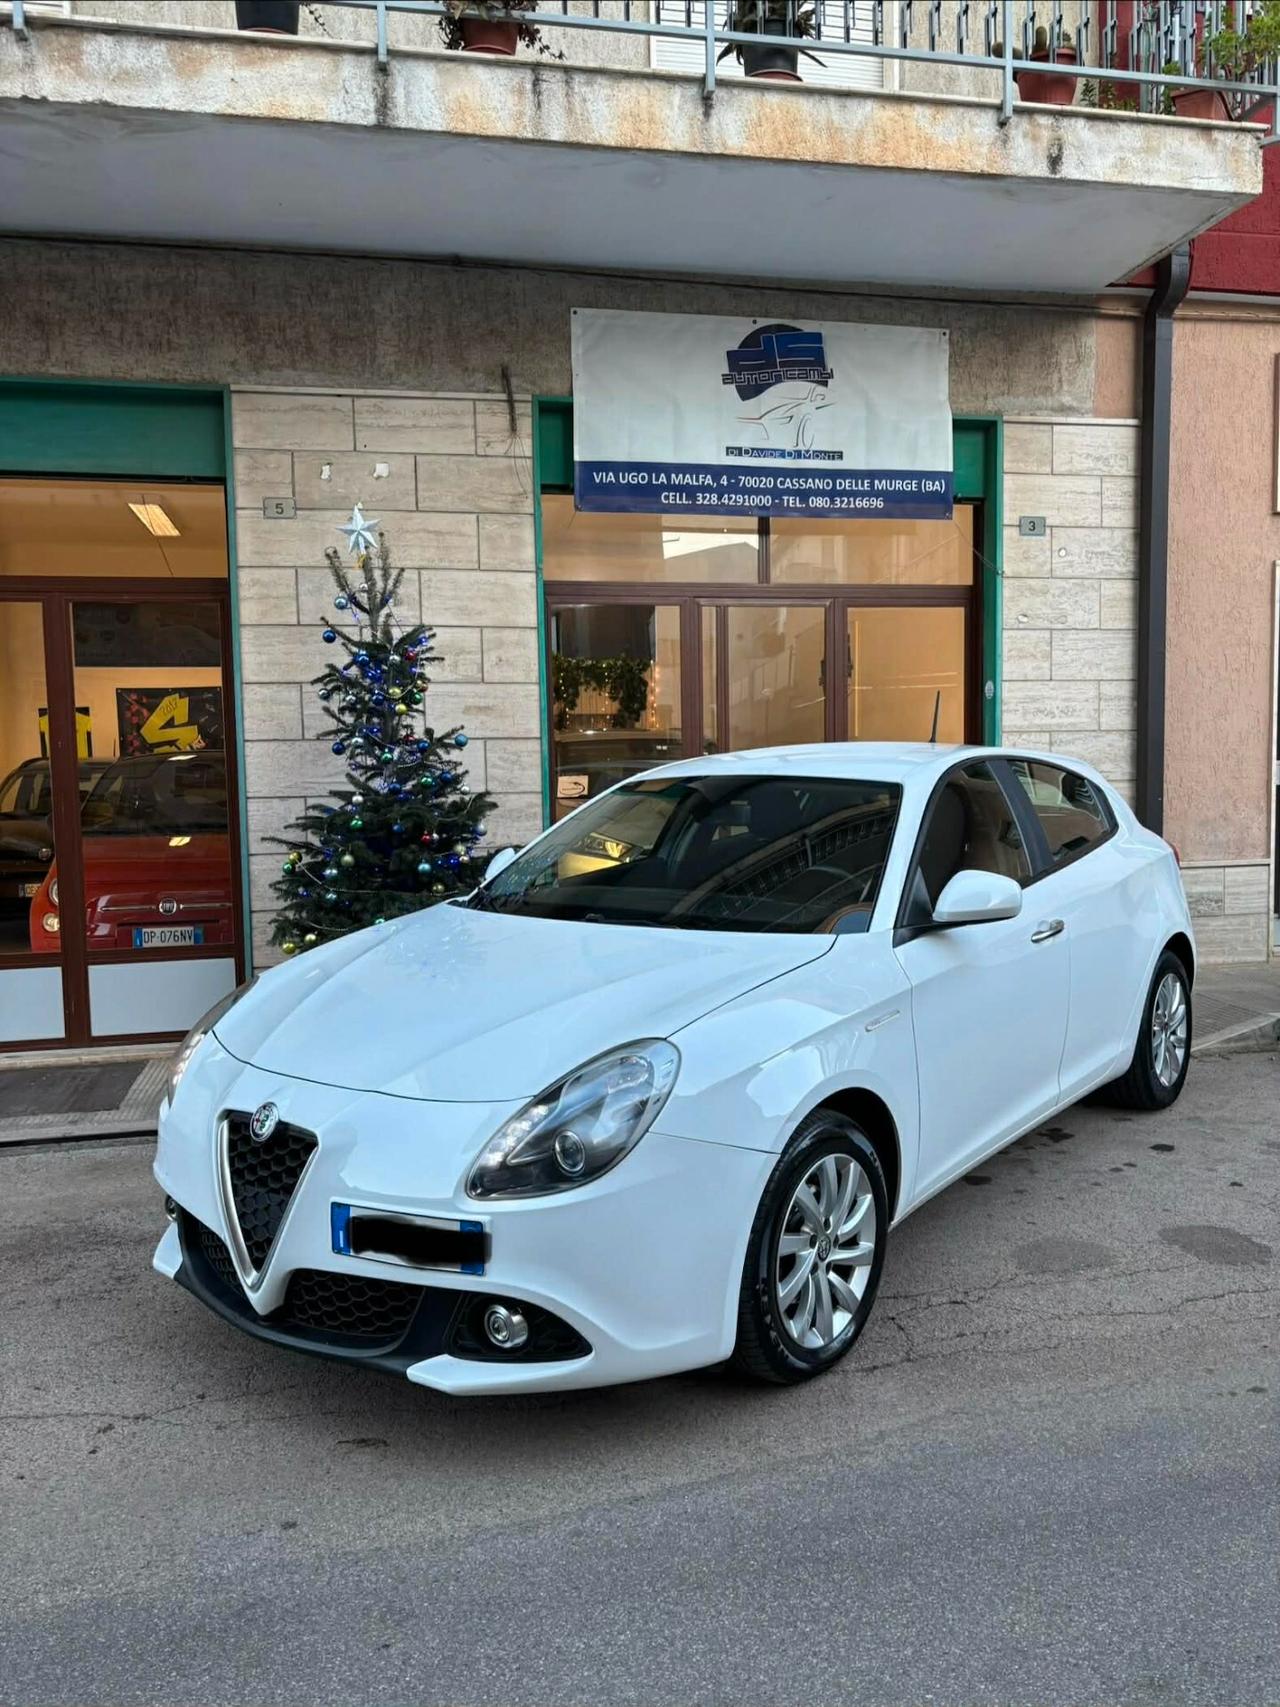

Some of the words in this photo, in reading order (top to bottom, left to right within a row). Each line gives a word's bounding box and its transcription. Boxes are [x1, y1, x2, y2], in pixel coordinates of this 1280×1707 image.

[593, 472, 616, 484] VIA
[619, 472, 648, 485] UGO
[652, 473, 668, 486] LA
[671, 473, 717, 488] MALFA,
[719, 474, 728, 487] 4
[738, 476, 774, 489] 70020
[777, 477, 833, 490] CASSANO
[836, 478, 871, 491] DELLE
[874, 479, 919, 492] MURGE
[921, 479, 946, 494] (BA)
[661, 492, 693, 505] CELL.
[695, 493, 772, 507] 328.4291000
[782, 496, 806, 508] TEL.
[808, 496, 885, 509] 080.3216696
[275, 503, 284, 515] 5
[1028, 520, 1036, 532] 3
